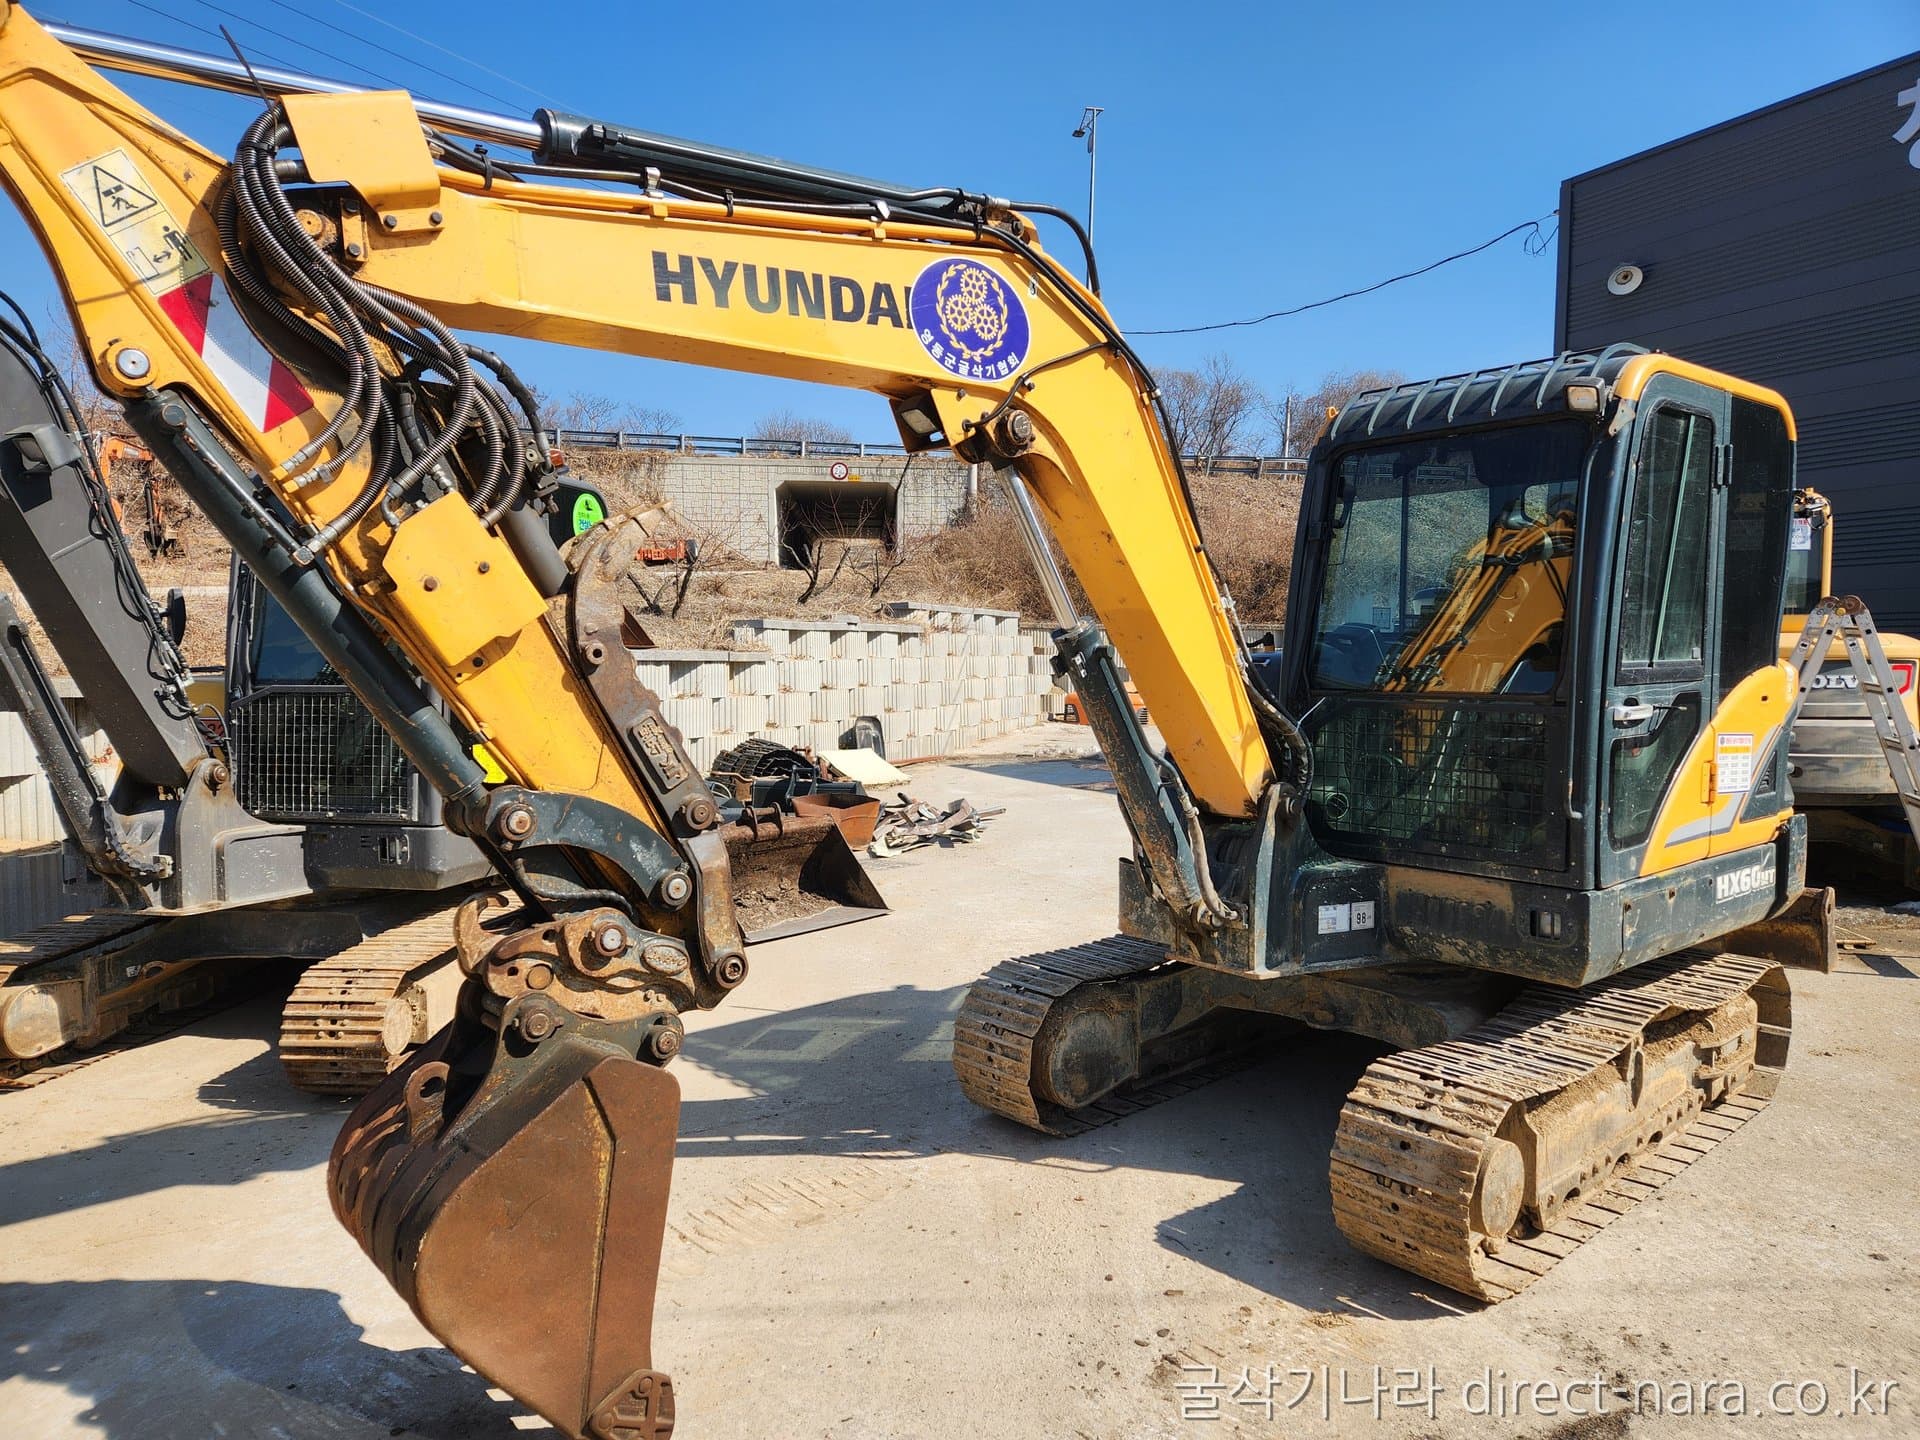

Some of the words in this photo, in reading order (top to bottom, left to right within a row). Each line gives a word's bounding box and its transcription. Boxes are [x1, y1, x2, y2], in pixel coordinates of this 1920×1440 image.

[920, 328, 1020, 379] 영동군굴삭기협회
[1811, 674, 1860, 690] OLV
[1356, 912, 1367, 925] 98
